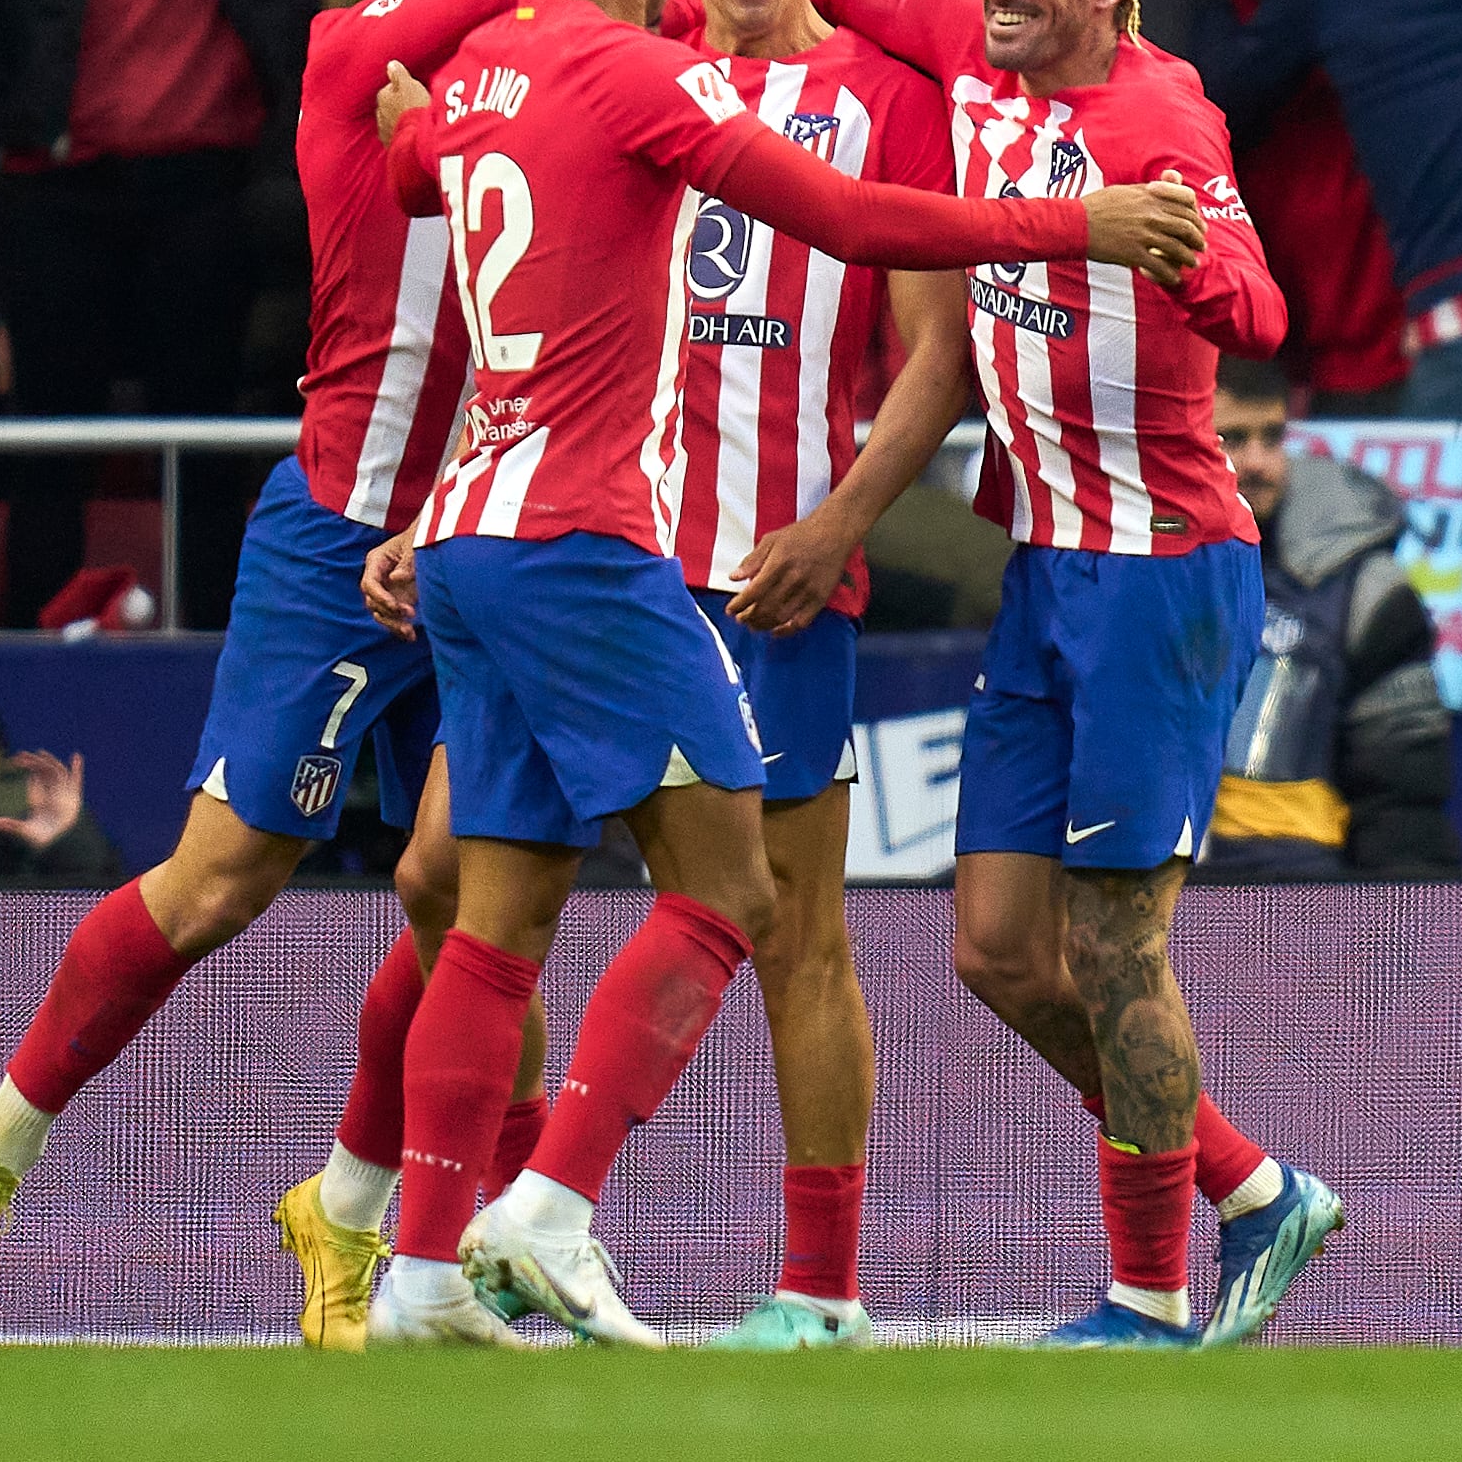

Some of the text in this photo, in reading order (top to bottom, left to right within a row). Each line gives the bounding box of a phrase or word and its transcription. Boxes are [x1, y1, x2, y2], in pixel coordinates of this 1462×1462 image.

[445, 66, 531, 125] S. LINO
[440, 151, 544, 372] 12
[736, 317, 786, 347] AIR
[1024, 304, 1068, 338] AIR
[320, 660, 369, 750] 7
